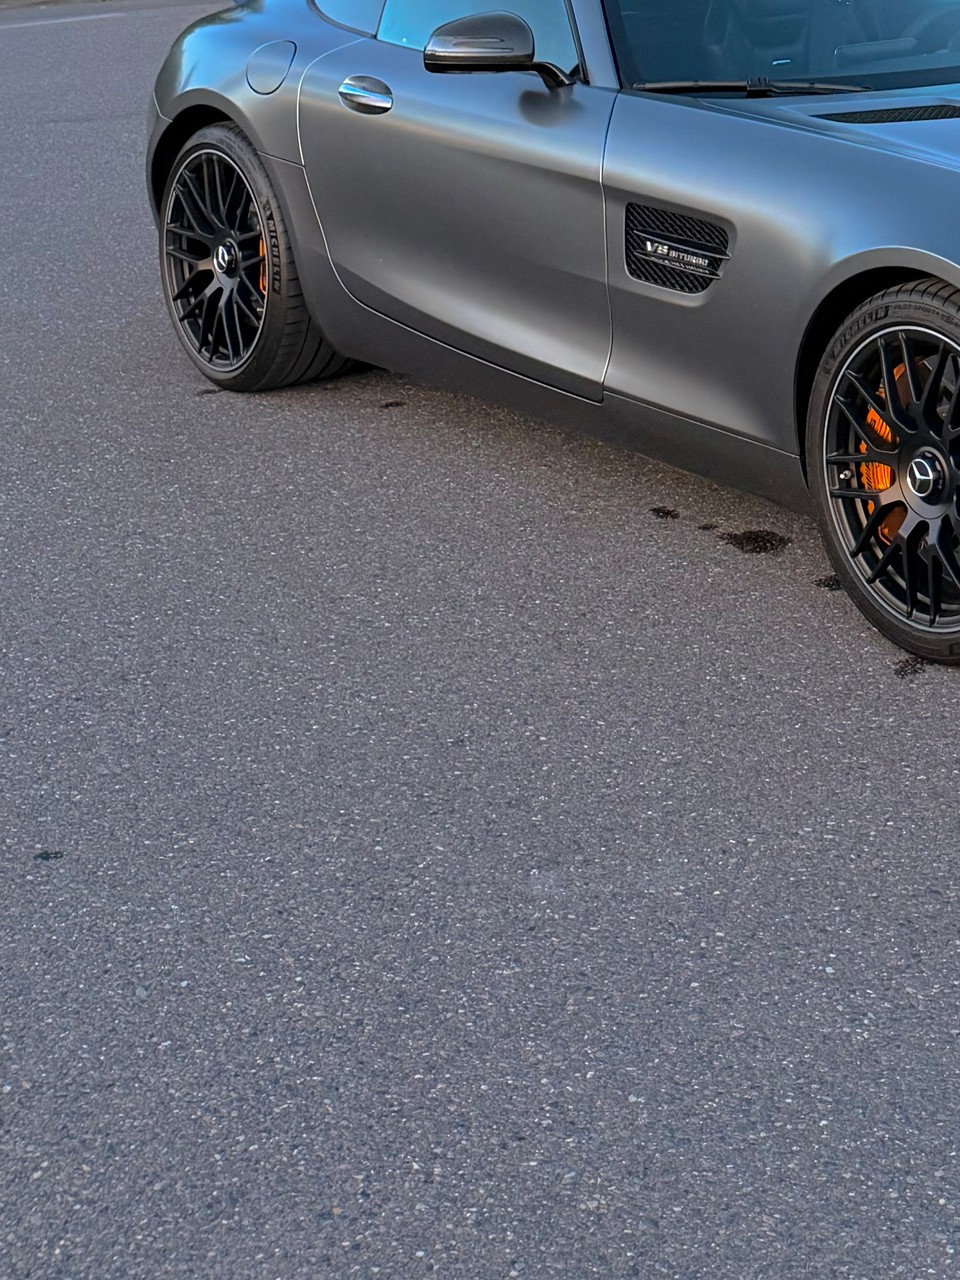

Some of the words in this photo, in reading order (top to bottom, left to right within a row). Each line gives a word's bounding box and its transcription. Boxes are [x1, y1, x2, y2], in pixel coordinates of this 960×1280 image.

[266, 219, 282, 295] MICHELIN
[646, 241, 669, 255] V8
[669, 250, 709, 266] BITURBO
